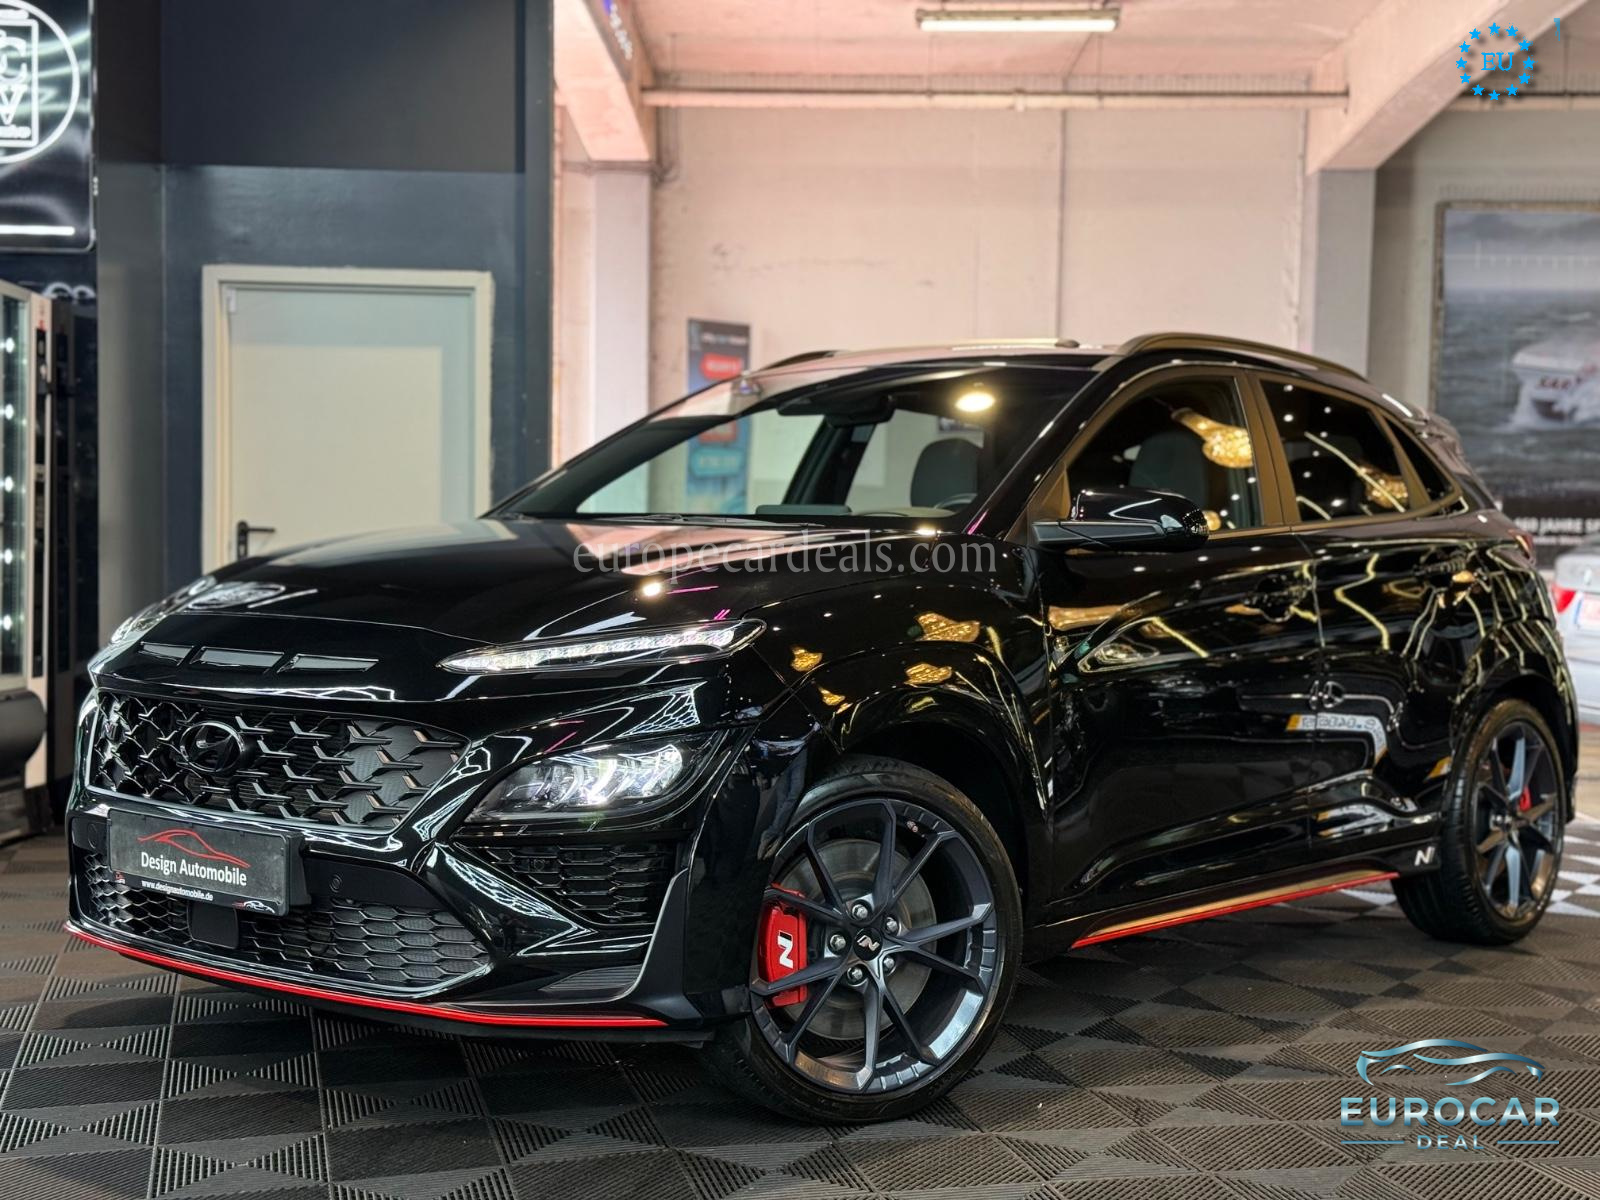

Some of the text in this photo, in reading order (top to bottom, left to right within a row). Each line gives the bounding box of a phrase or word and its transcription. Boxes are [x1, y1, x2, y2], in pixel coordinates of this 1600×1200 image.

[141, 851, 247, 887] Design Automobile
[141, 879, 214, 902] www.designautomobile.de
